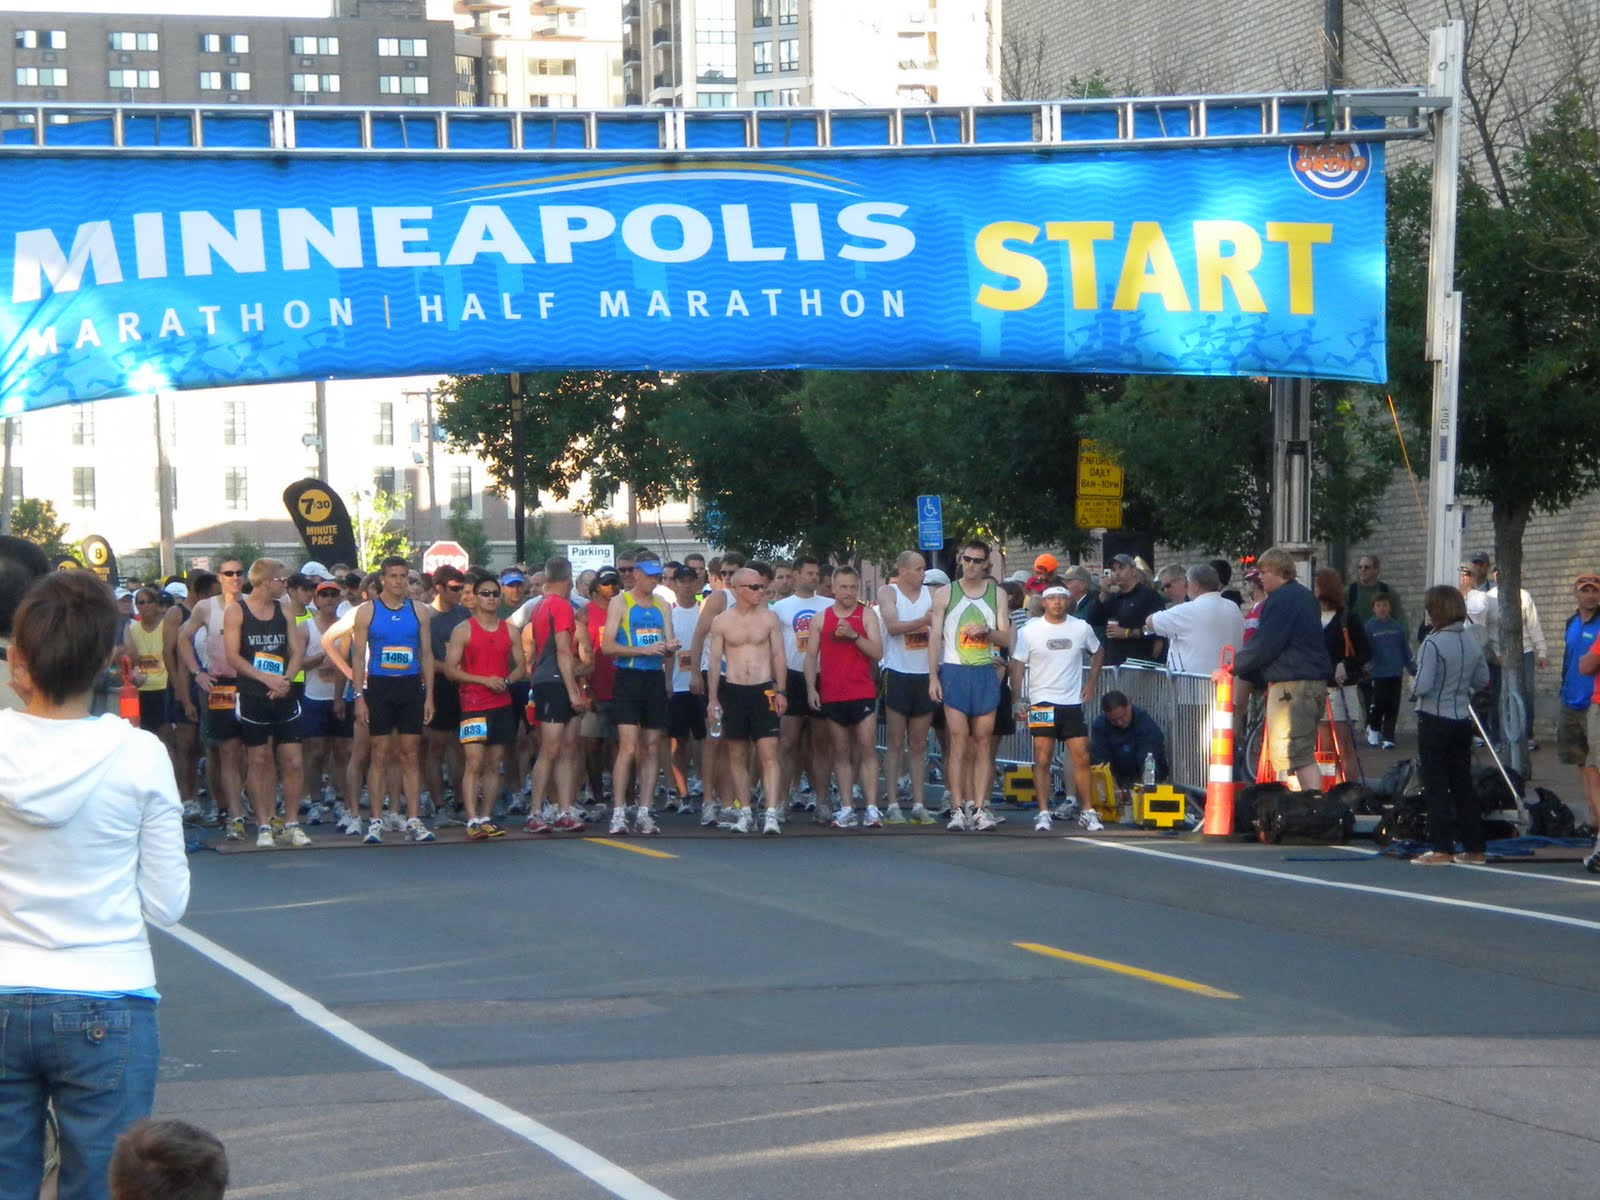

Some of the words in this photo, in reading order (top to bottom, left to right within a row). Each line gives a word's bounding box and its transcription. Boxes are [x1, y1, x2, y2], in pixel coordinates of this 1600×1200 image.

[1295, 156, 1366, 172] ORTHO
[12, 201, 916, 304] MINNEAPOLIS
[974, 220, 1334, 315] START
[24, 297, 353, 359] MARATHON
[419, 292, 555, 323] HALF
[599, 288, 905, 319] MARATHON
[1080, 455, 1115, 467] ENFORC
[1090, 468, 1112, 478] DAILY
[305, 524, 338, 536] MINUTE
[311, 535, 335, 546] PACE
[95, 548, 103, 560] 8
[572, 547, 611, 558] Parking
[256, 659, 281, 674] 1099
